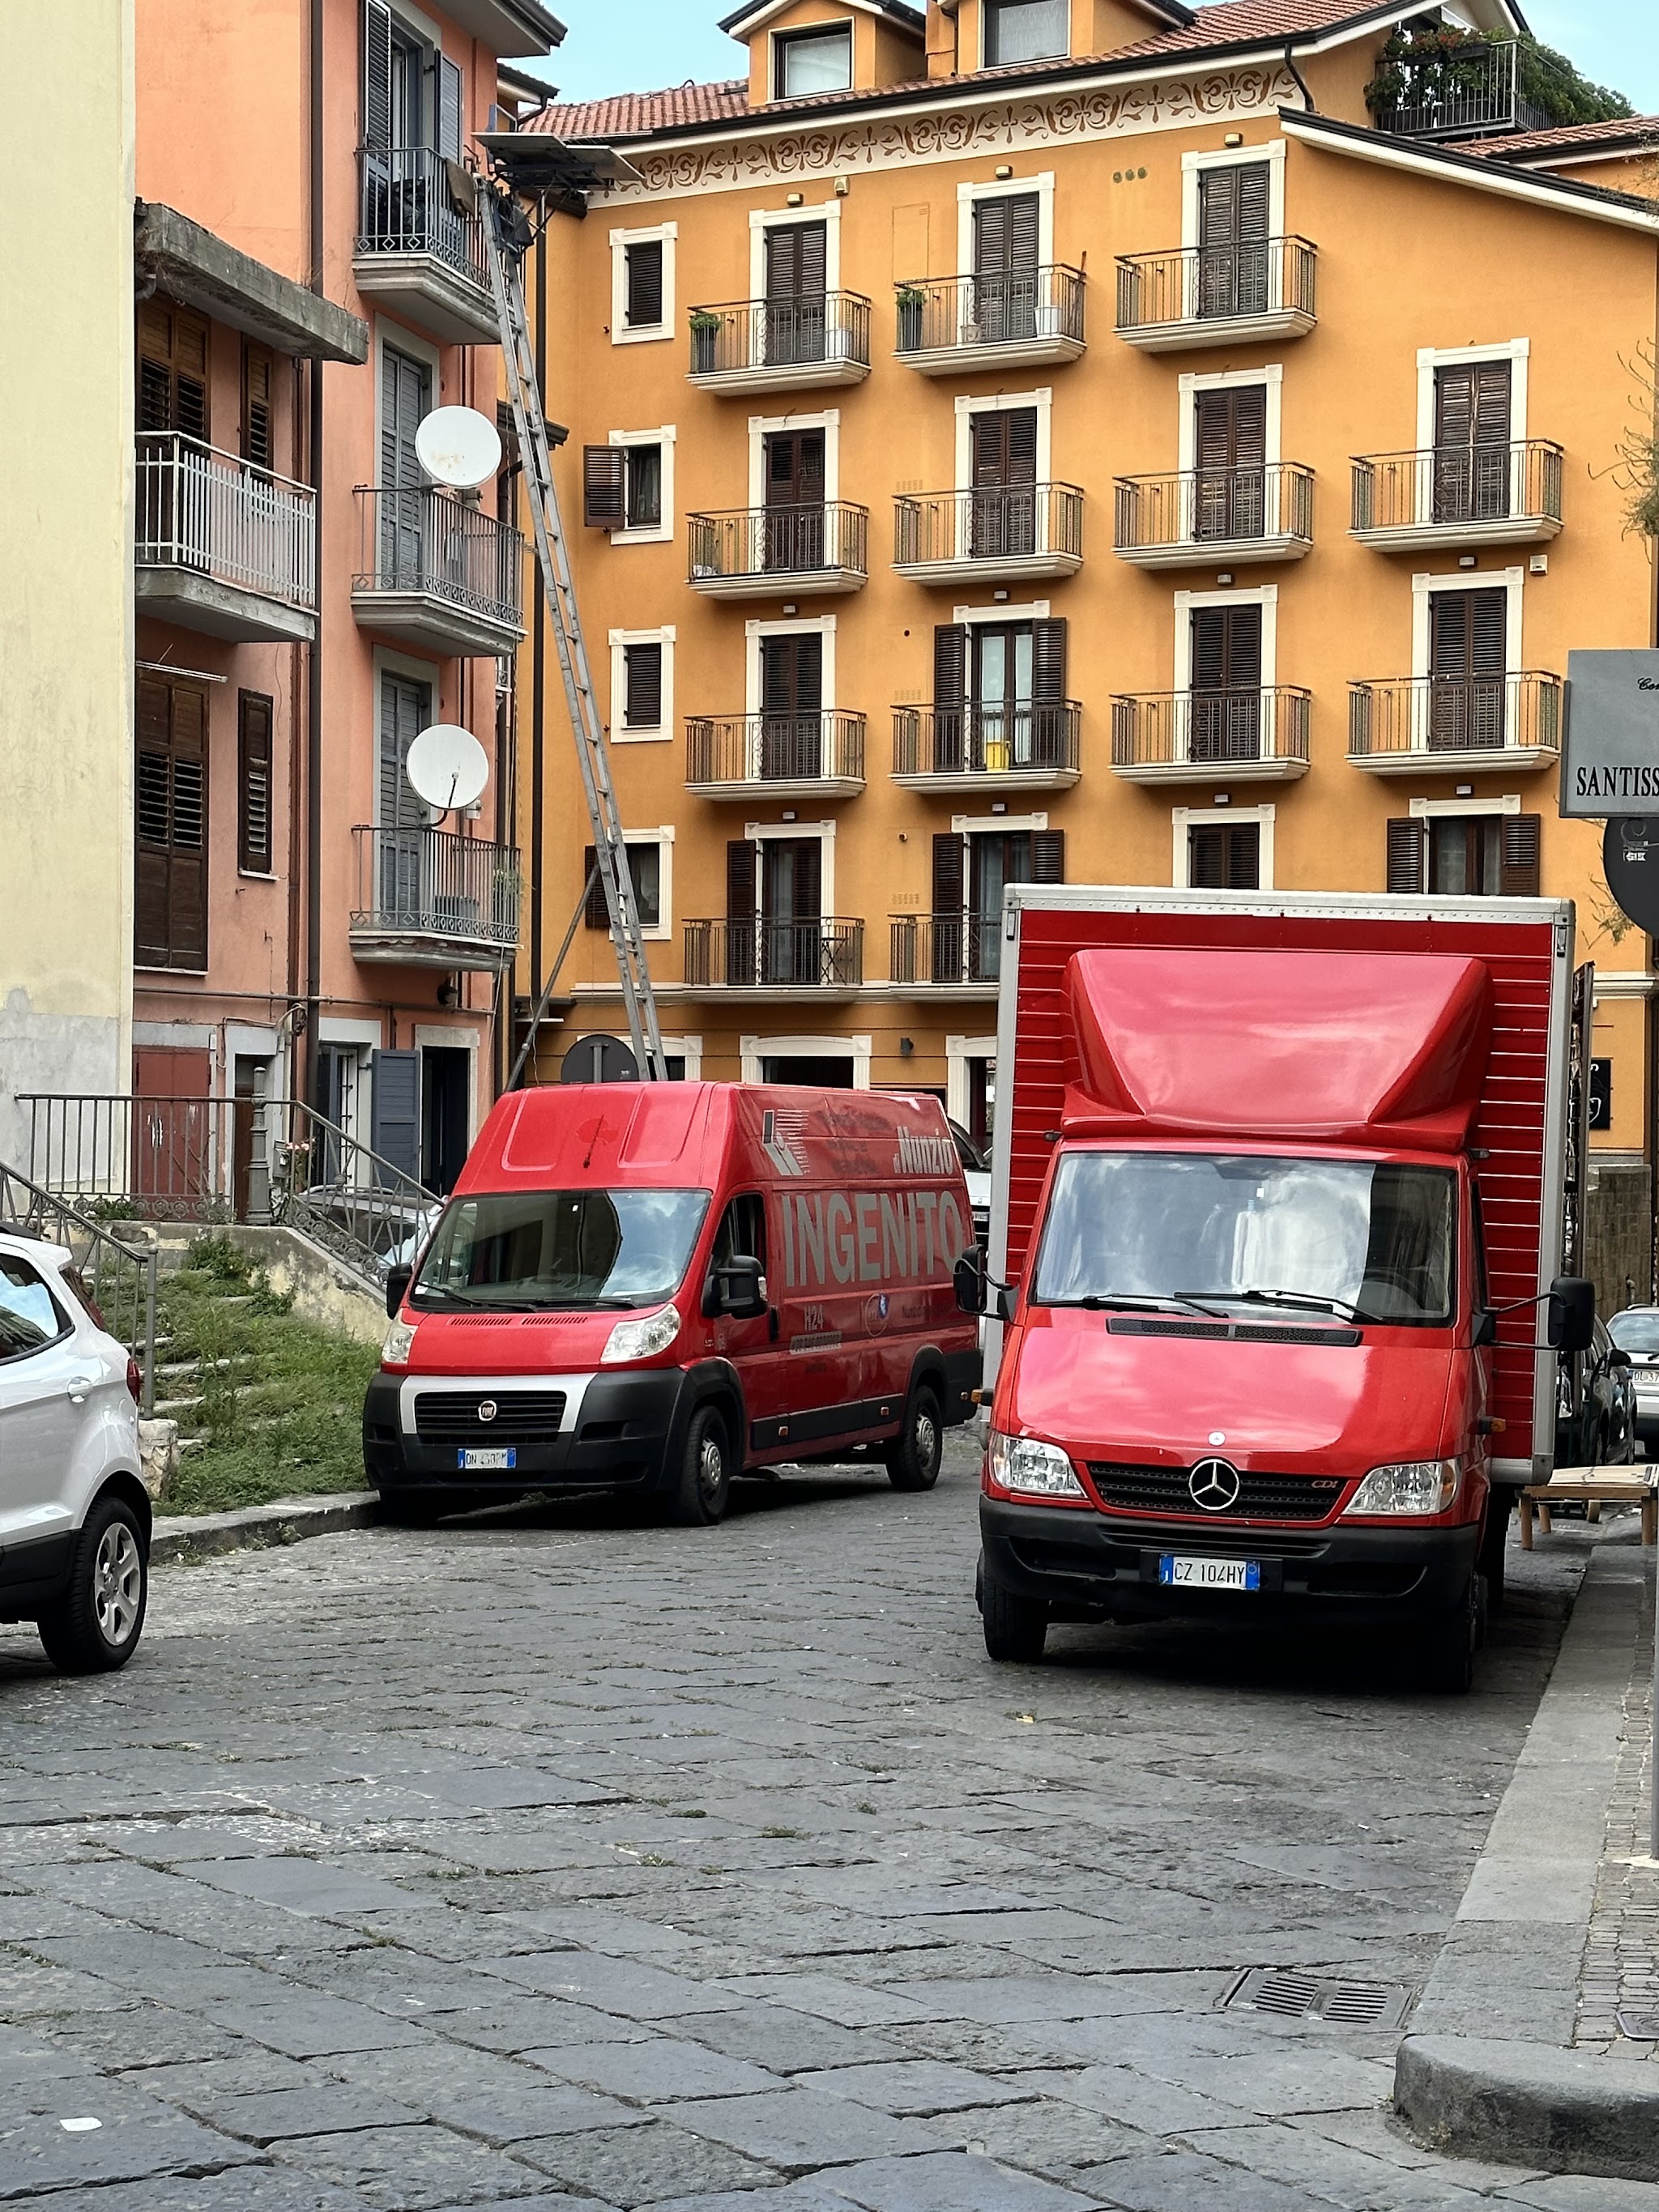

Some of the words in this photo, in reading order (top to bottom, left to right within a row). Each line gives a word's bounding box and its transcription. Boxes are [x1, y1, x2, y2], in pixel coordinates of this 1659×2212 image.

[1576, 765, 1659, 798] SANTISS
[897, 1126, 954, 1175] Nunzio
[782, 1191, 964, 1288] INGENITO
[804, 1304, 824, 1332] H24
[1175, 1562, 1192, 1581] CZ
[1201, 1563, 1245, 1585] 104HY
